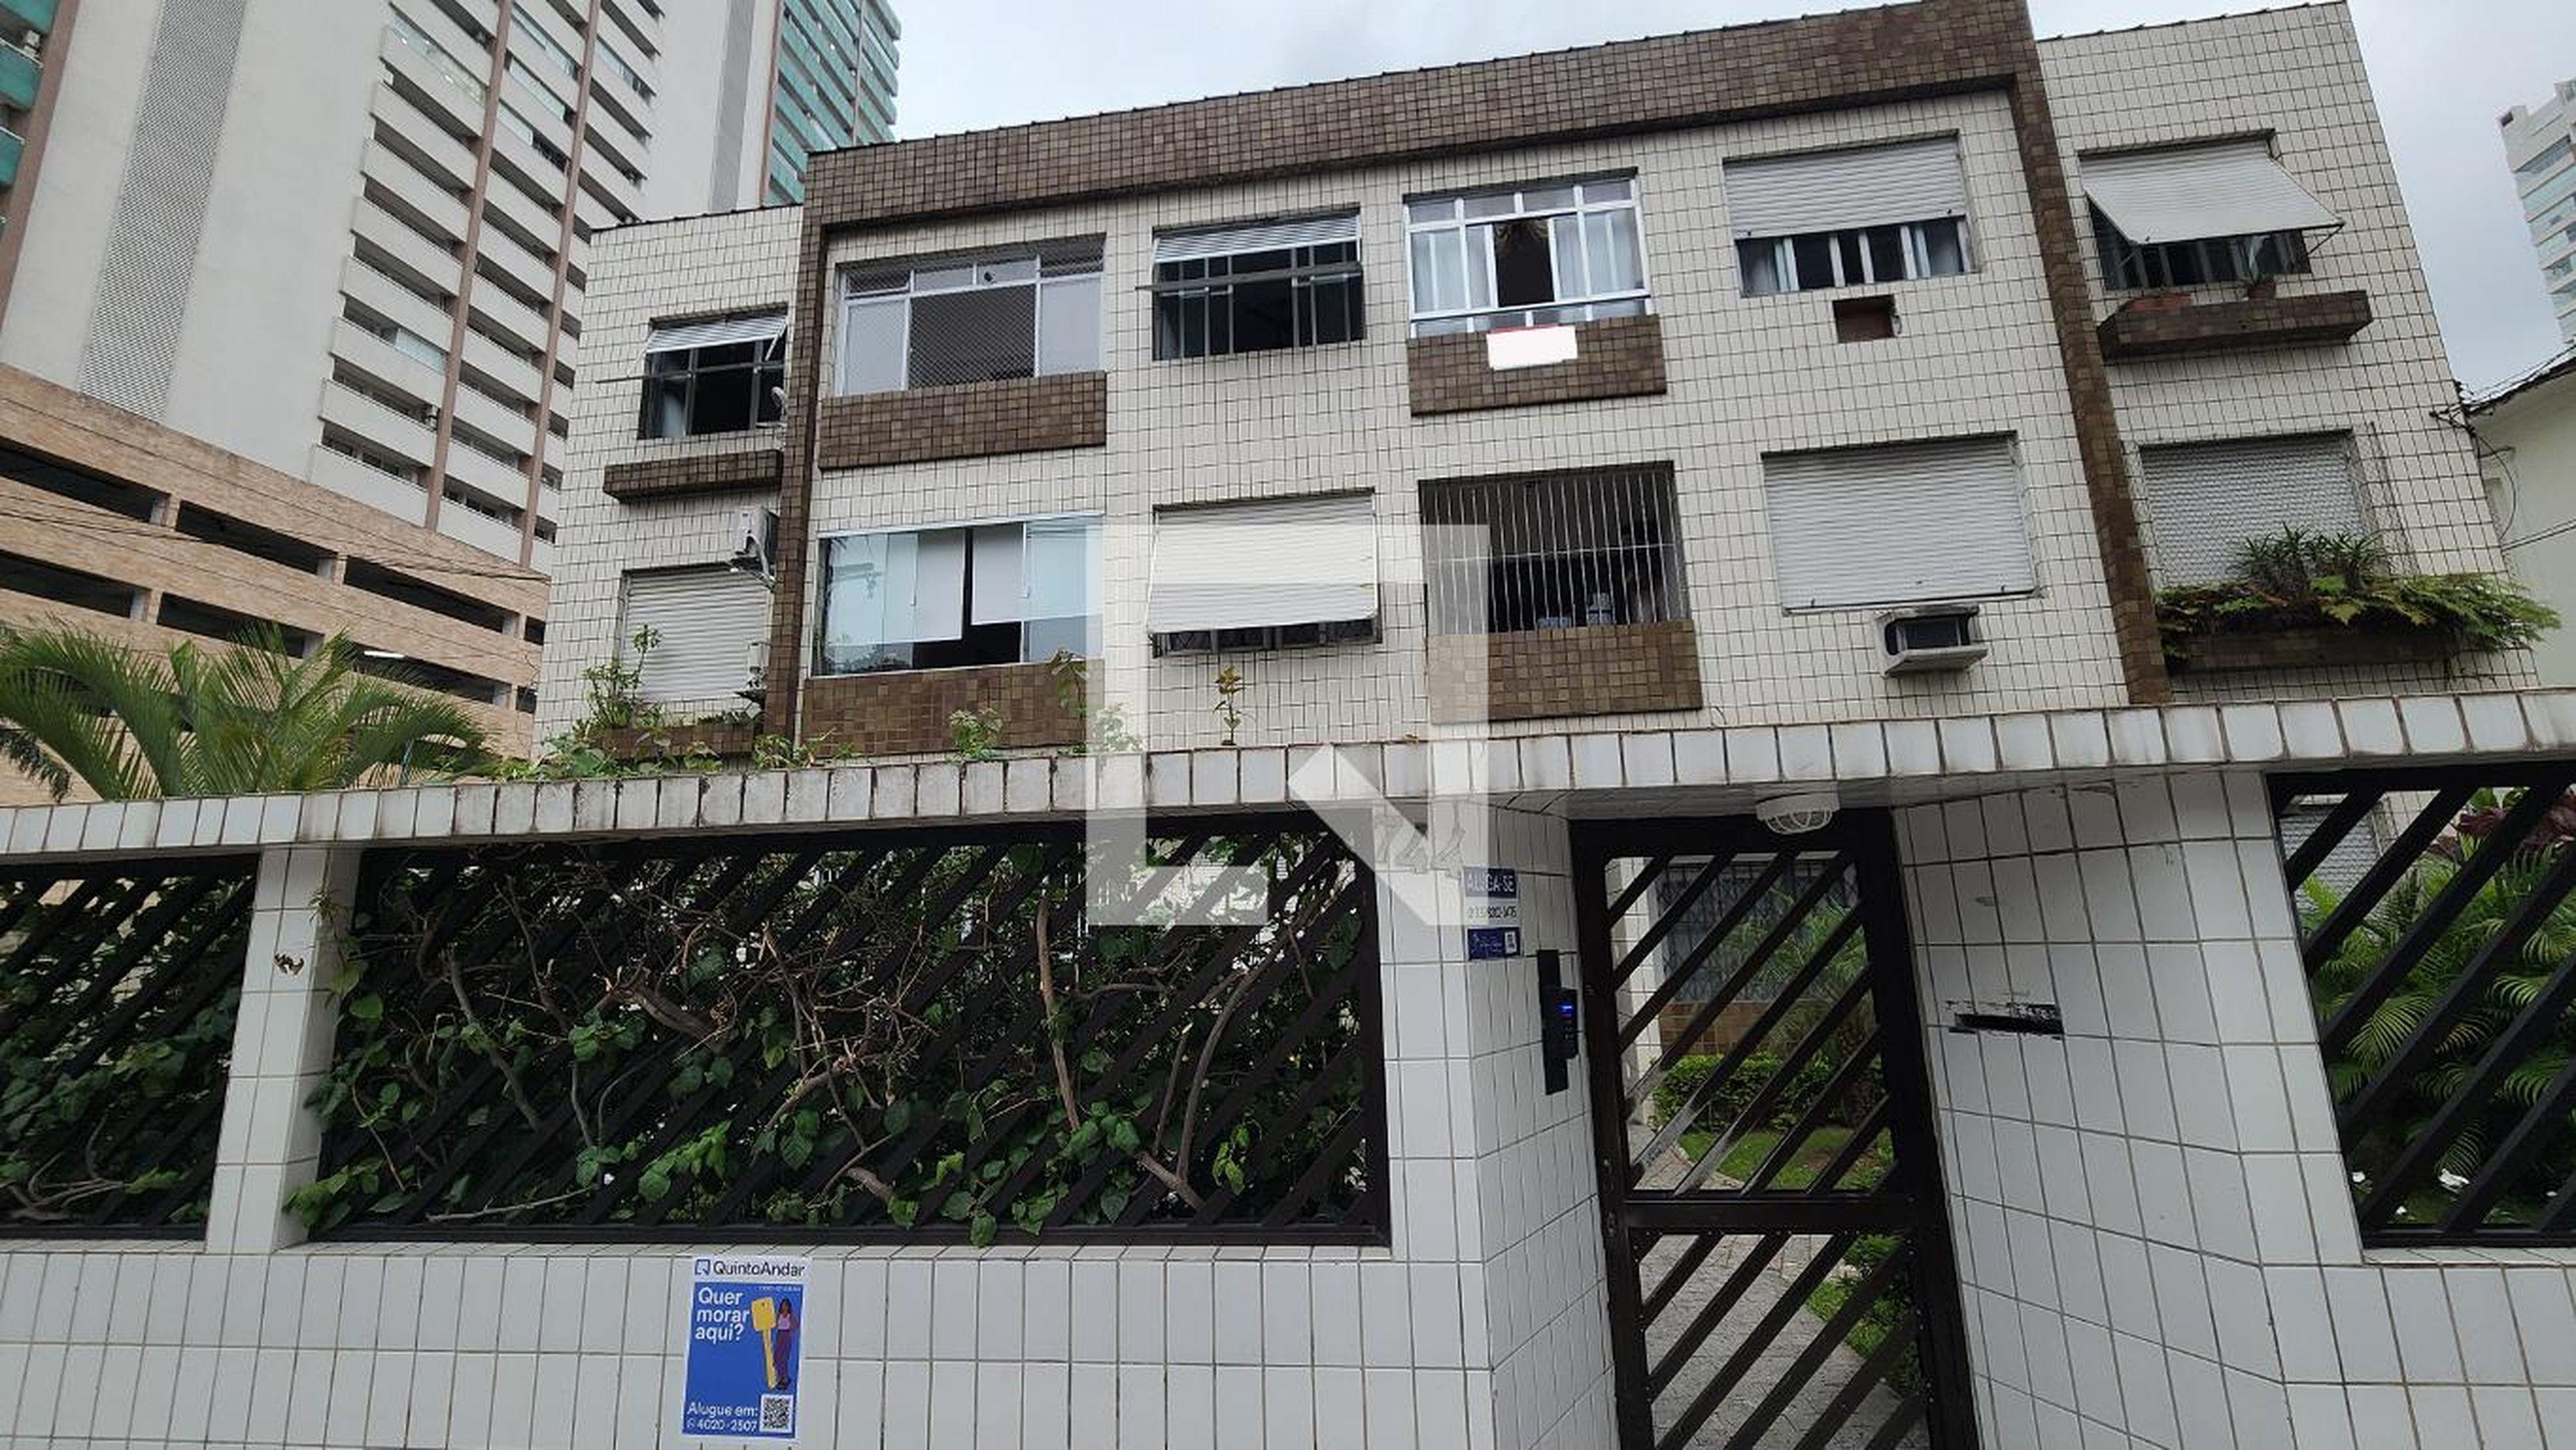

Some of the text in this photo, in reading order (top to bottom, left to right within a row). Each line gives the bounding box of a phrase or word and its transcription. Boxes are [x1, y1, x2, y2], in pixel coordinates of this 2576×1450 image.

[713, 1261, 805, 1277] QuintoAndar
[698, 1286, 743, 1305] Quer
[696, 1308, 750, 1323] morar
[694, 1323, 744, 1345] aqui?
[687, 1402, 759, 1418] Alugue em:
